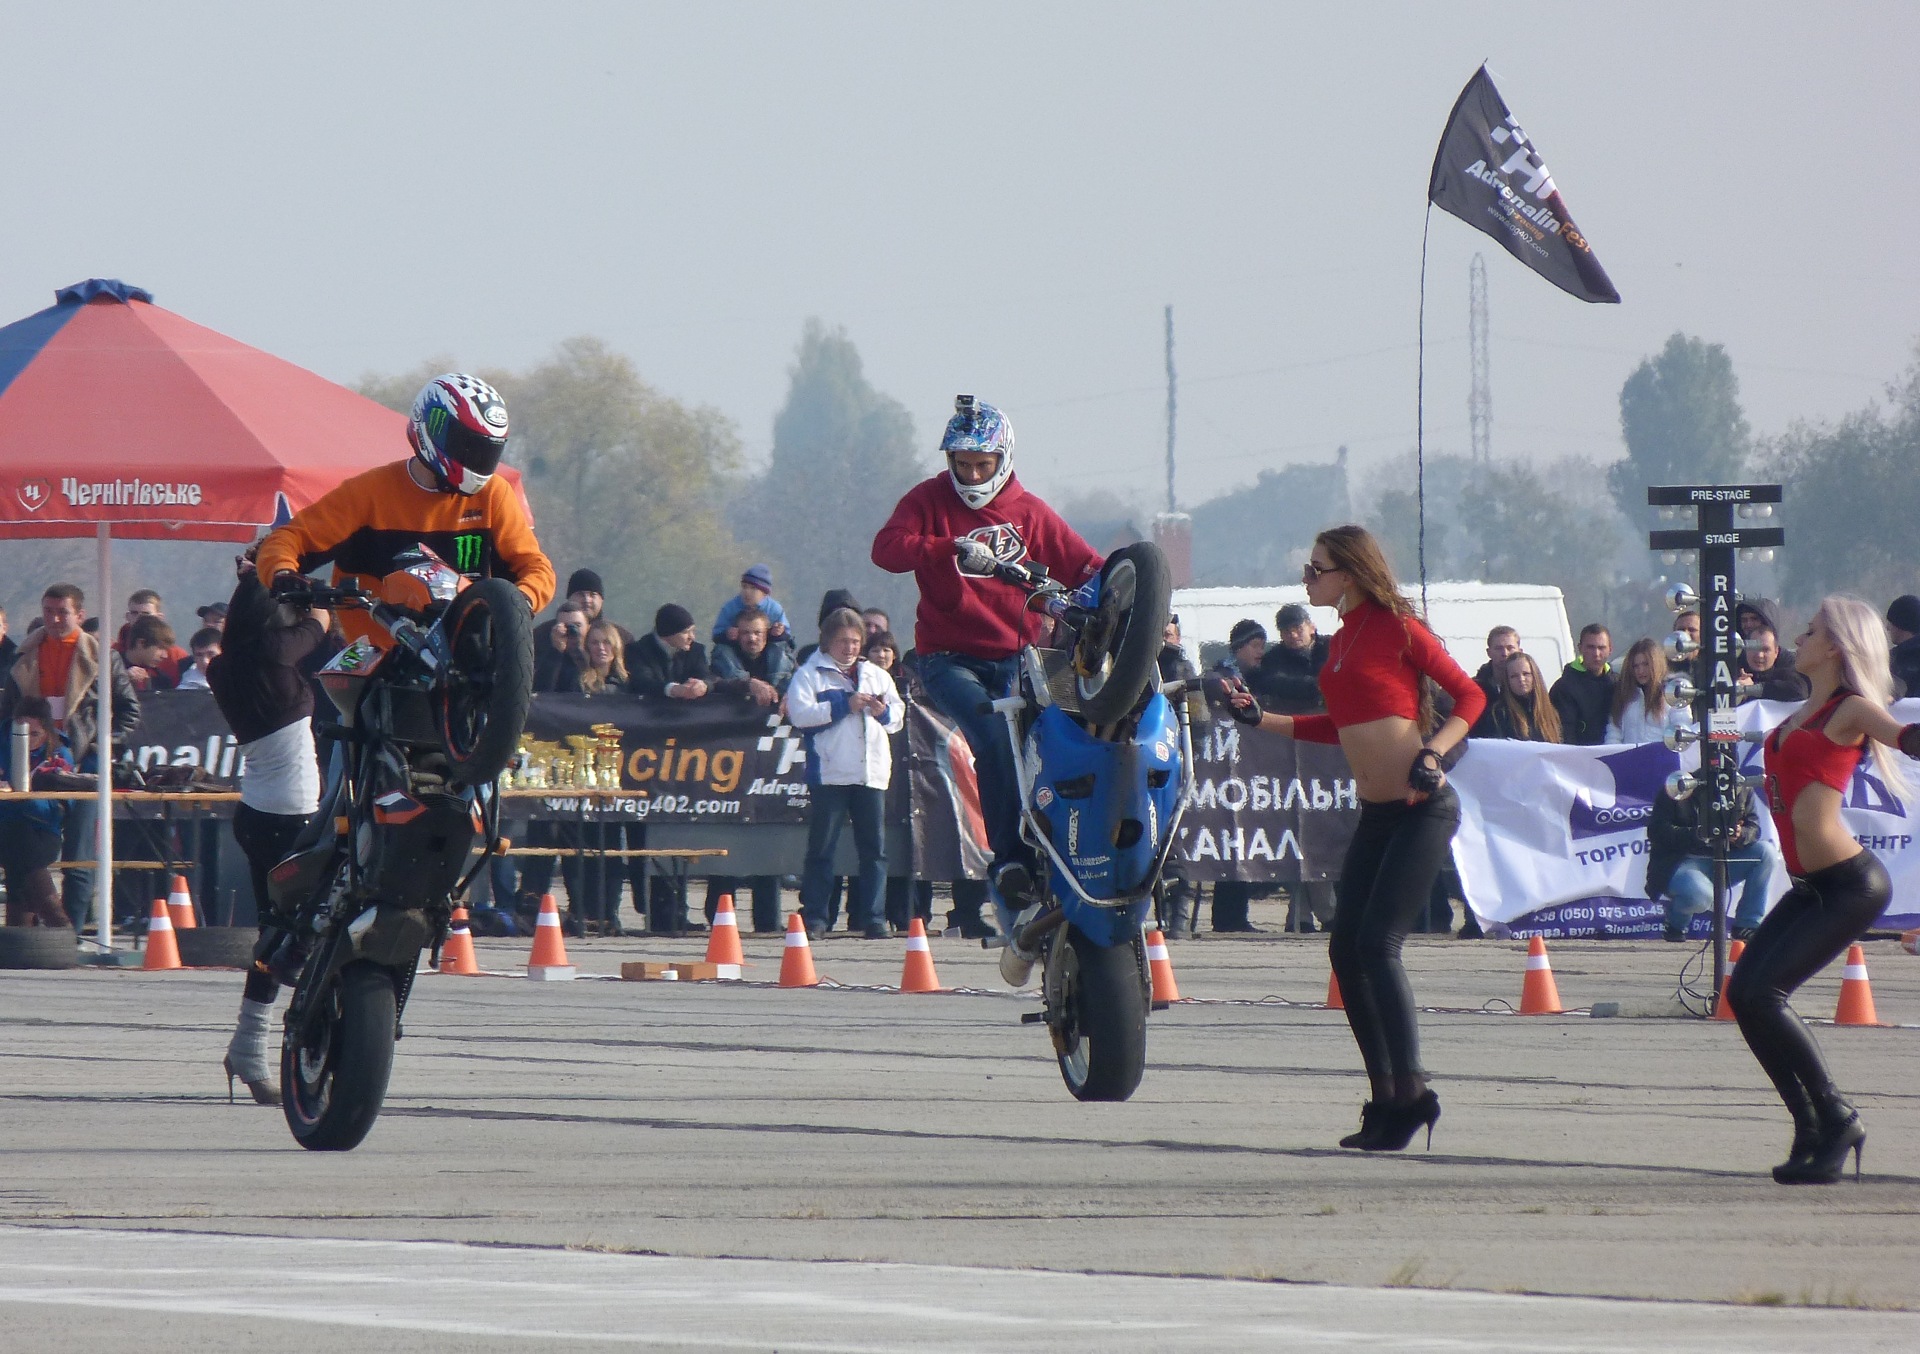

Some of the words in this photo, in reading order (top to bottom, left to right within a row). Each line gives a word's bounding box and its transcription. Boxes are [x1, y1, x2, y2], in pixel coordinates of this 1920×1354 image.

[1465, 159, 1561, 233] Adrenalin
[1691, 490, 1751, 501] PRE-STAGE
[1705, 533, 1740, 544] STAGE
[1713, 574, 1729, 654] RACE
[1710, 660, 1734, 811] AMICA
[616, 738, 744, 793] cing
[1576, 839, 1651, 866] ТОРГОВ
[1560, 907, 1594, 922] (050)
